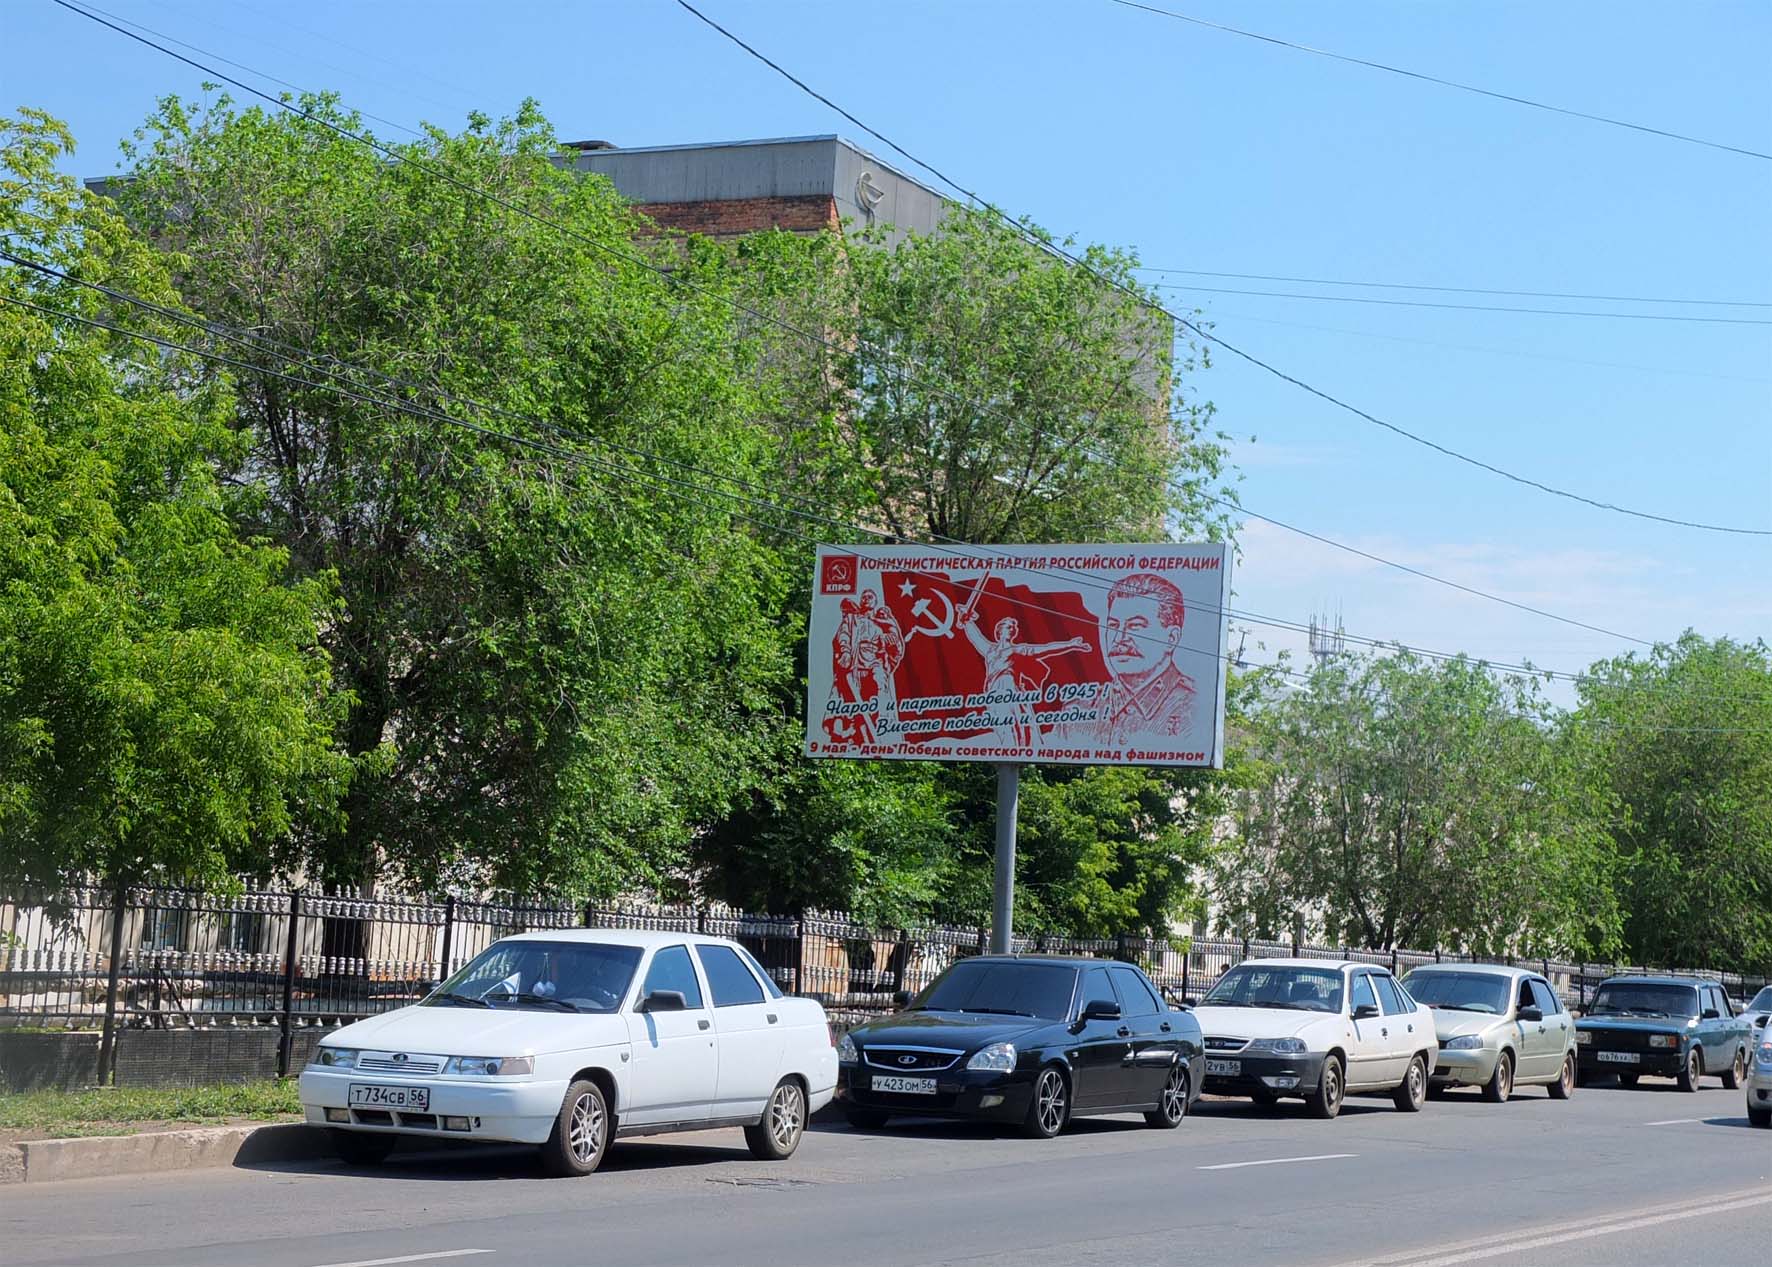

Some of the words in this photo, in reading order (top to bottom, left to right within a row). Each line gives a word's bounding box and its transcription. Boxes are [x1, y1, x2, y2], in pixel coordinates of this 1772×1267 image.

[860, 557, 992, 570] КОММУНИСТИЧЕСКАЯ
[996, 557, 1045, 570] ПАРТИЯ
[1050, 554, 1135, 569] РОССИЙСКОЙ
[1139, 556, 1220, 571] ФЕДЕРАЦИИ
[826, 584, 851, 592] КПРФ
[826, 698, 878, 714] Народ
[886, 702, 896, 711] и
[901, 697, 962, 713] партия
[967, 689, 1040, 706] победили
[1047, 685, 1056, 700] в
[1061, 684, 1097, 699] 1945
[877, 718, 940, 736] Вместе
[946, 712, 1014, 729] победим
[1020, 715, 1031, 724] и
[1036, 707, 1096, 724] сегодня
[810, 742, 818, 752] 9
[822, 744, 847, 753] мая
[861, 745, 893, 755] день
[899, 744, 952, 756] Победы
[956, 746, 1033, 757] советского
[1037, 750, 1090, 760] народа
[1095, 750, 1121, 760] над
[1126, 749, 1204, 761] фашизмом
[921, 1079, 933, 1089] 56
[410, 1089, 424, 1101] 56
